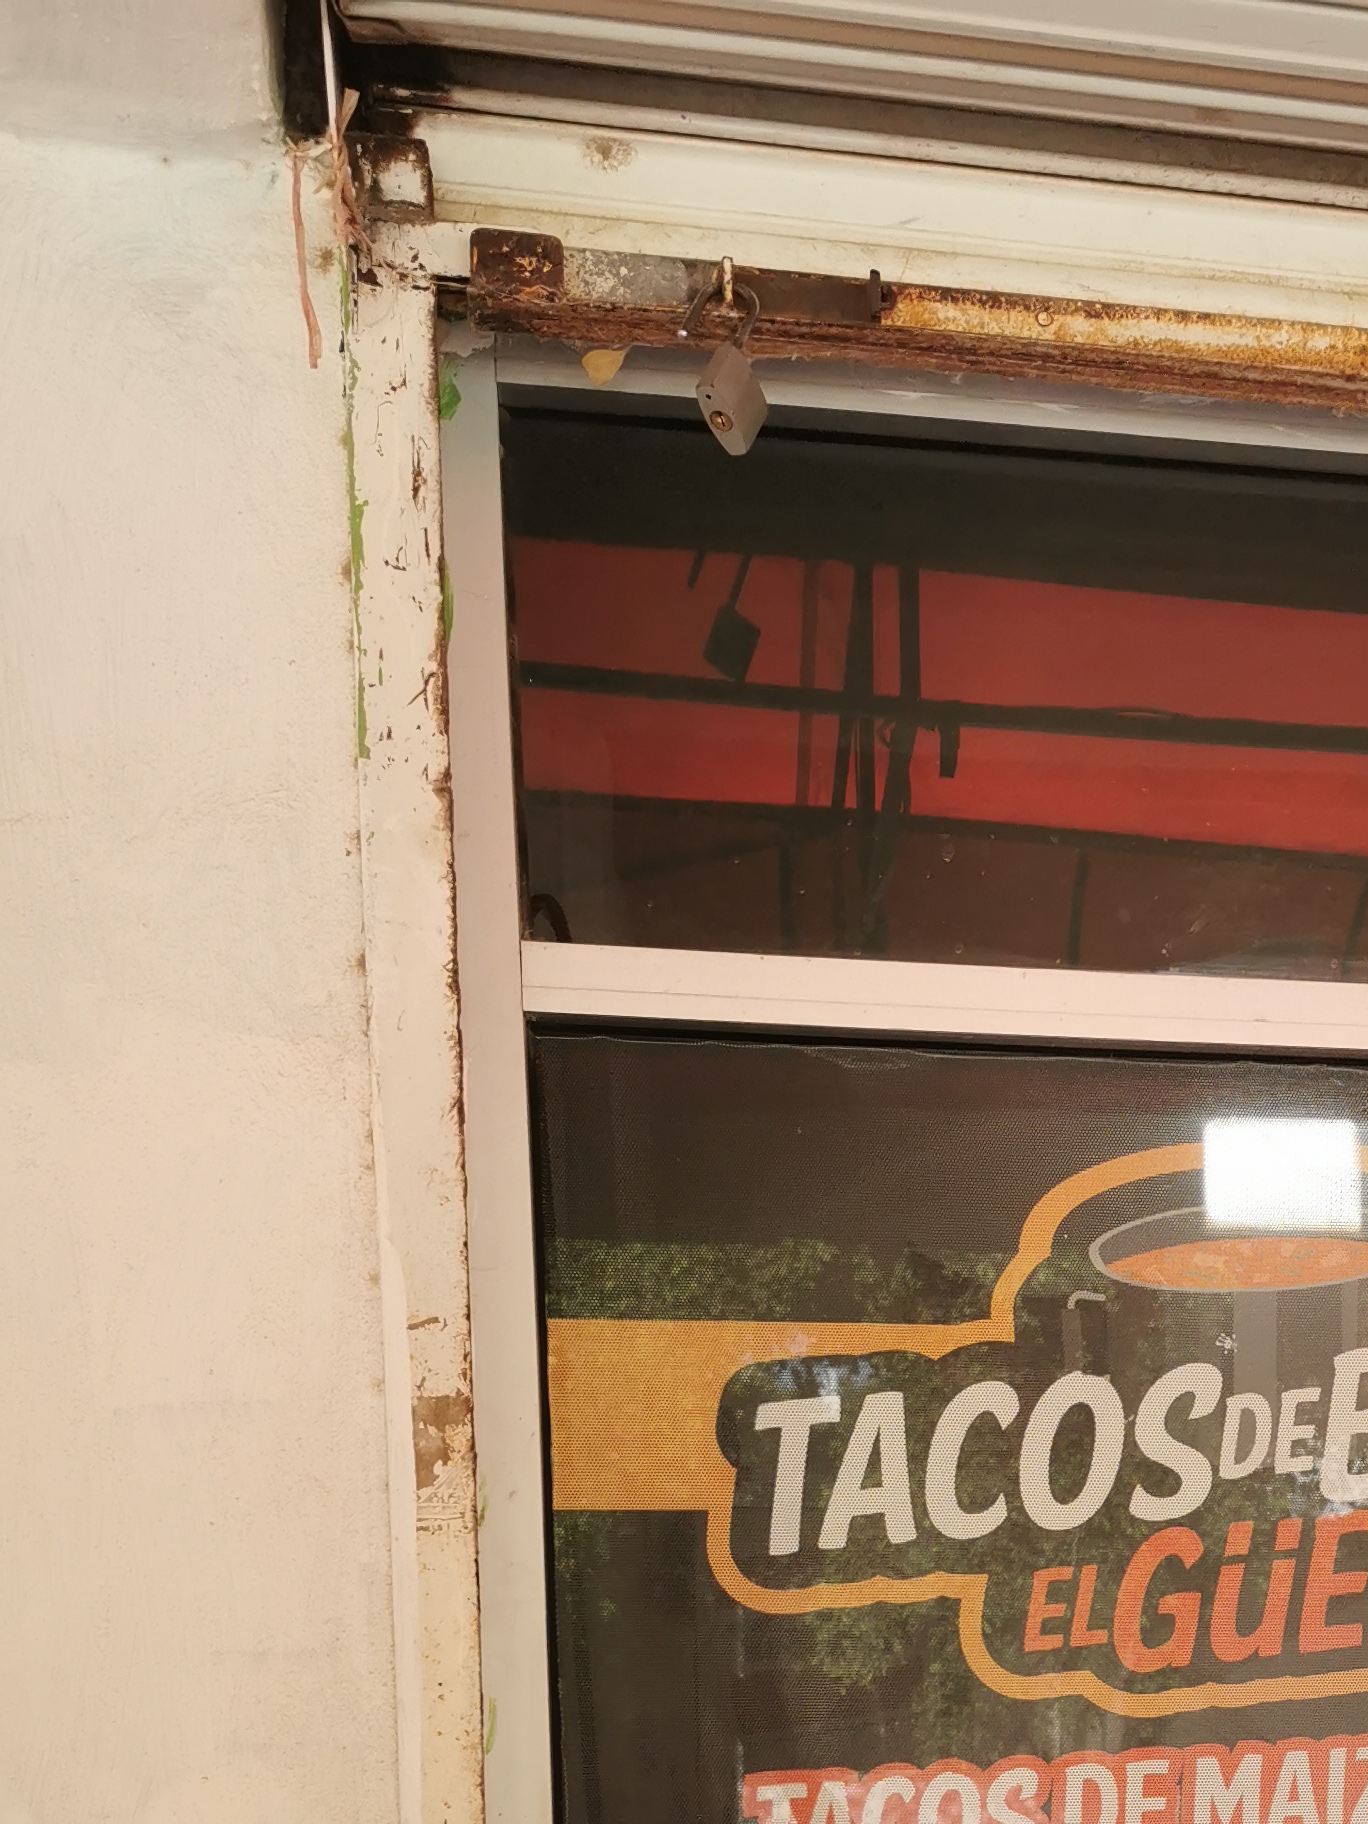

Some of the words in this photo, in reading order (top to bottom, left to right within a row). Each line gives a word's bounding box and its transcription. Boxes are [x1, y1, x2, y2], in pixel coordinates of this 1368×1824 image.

[755, 1362, 1224, 1556] TACOS
[1219, 1386, 1321, 1480] DE
[1023, 1563, 1110, 1652] EL
